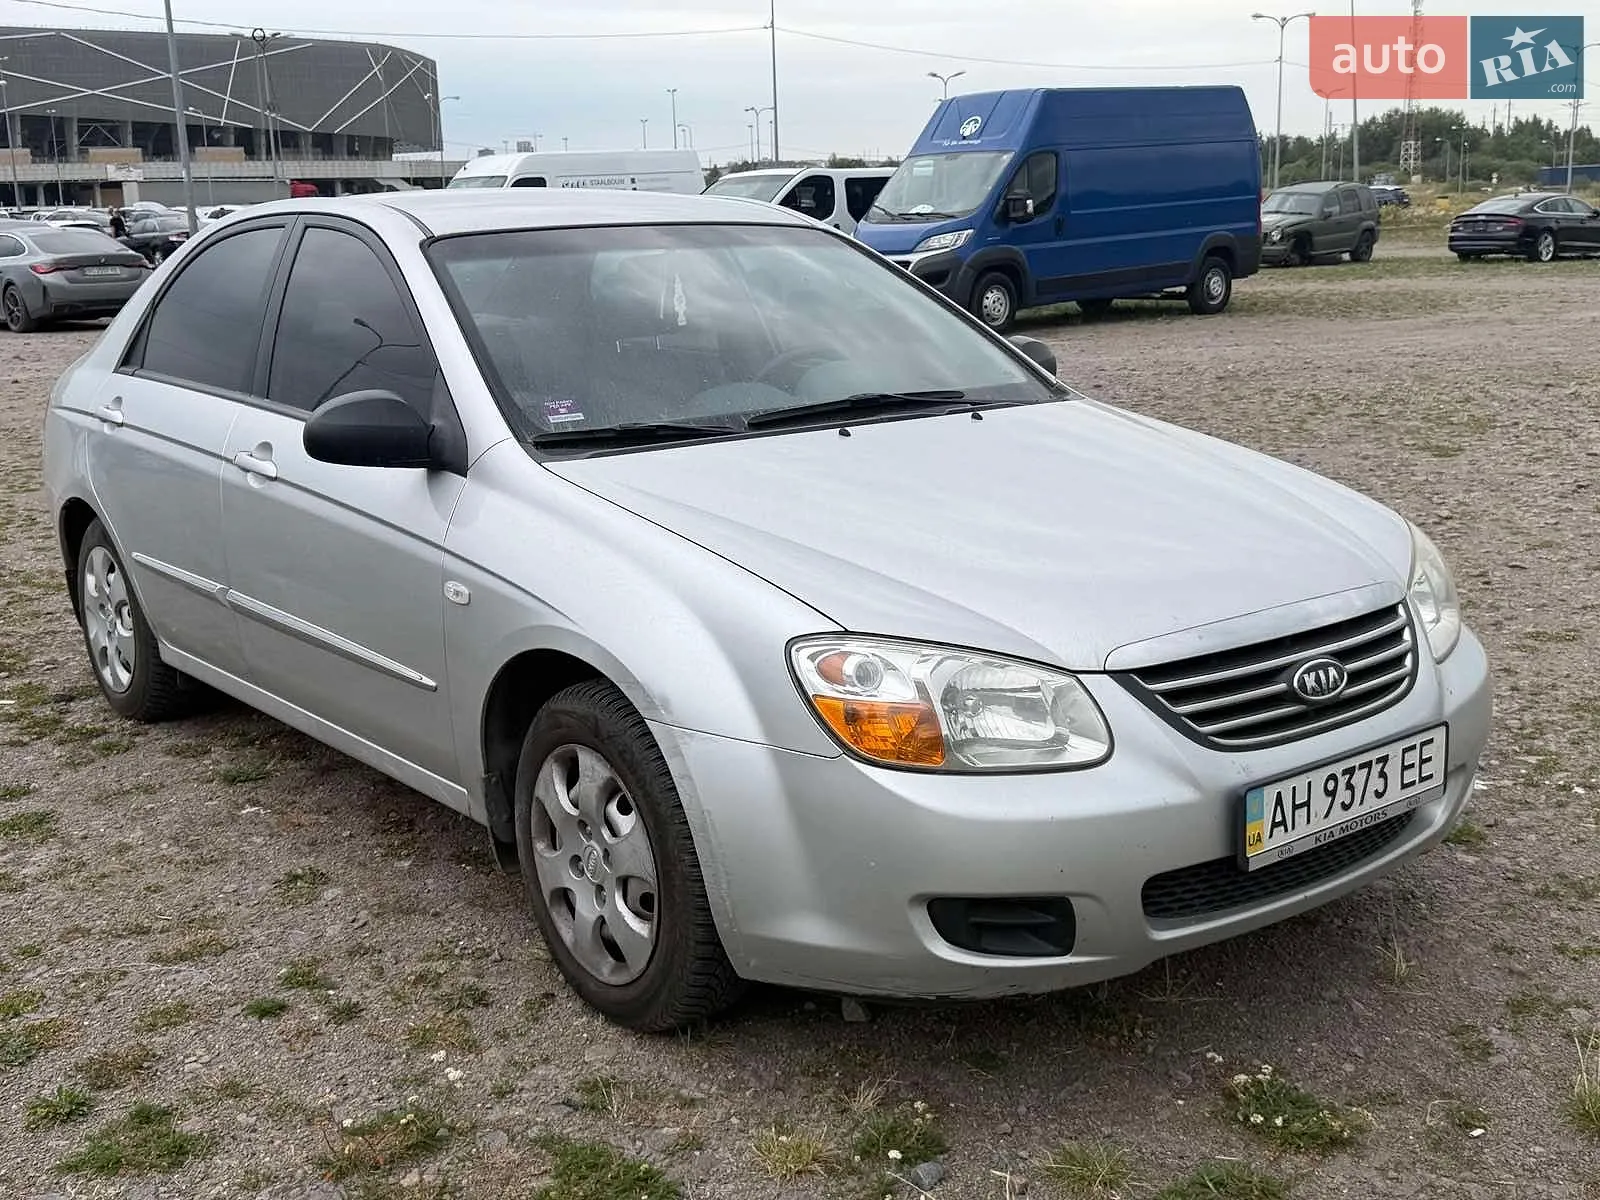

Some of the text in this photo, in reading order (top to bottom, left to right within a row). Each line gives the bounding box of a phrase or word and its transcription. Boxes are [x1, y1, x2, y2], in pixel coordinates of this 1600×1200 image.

[1302, 666, 1341, 695] KIA
[1268, 737, 1434, 839] AH 9373 EE
[1248, 831, 1262, 846] UA
[1313, 810, 1388, 845] KIA MOTORS
